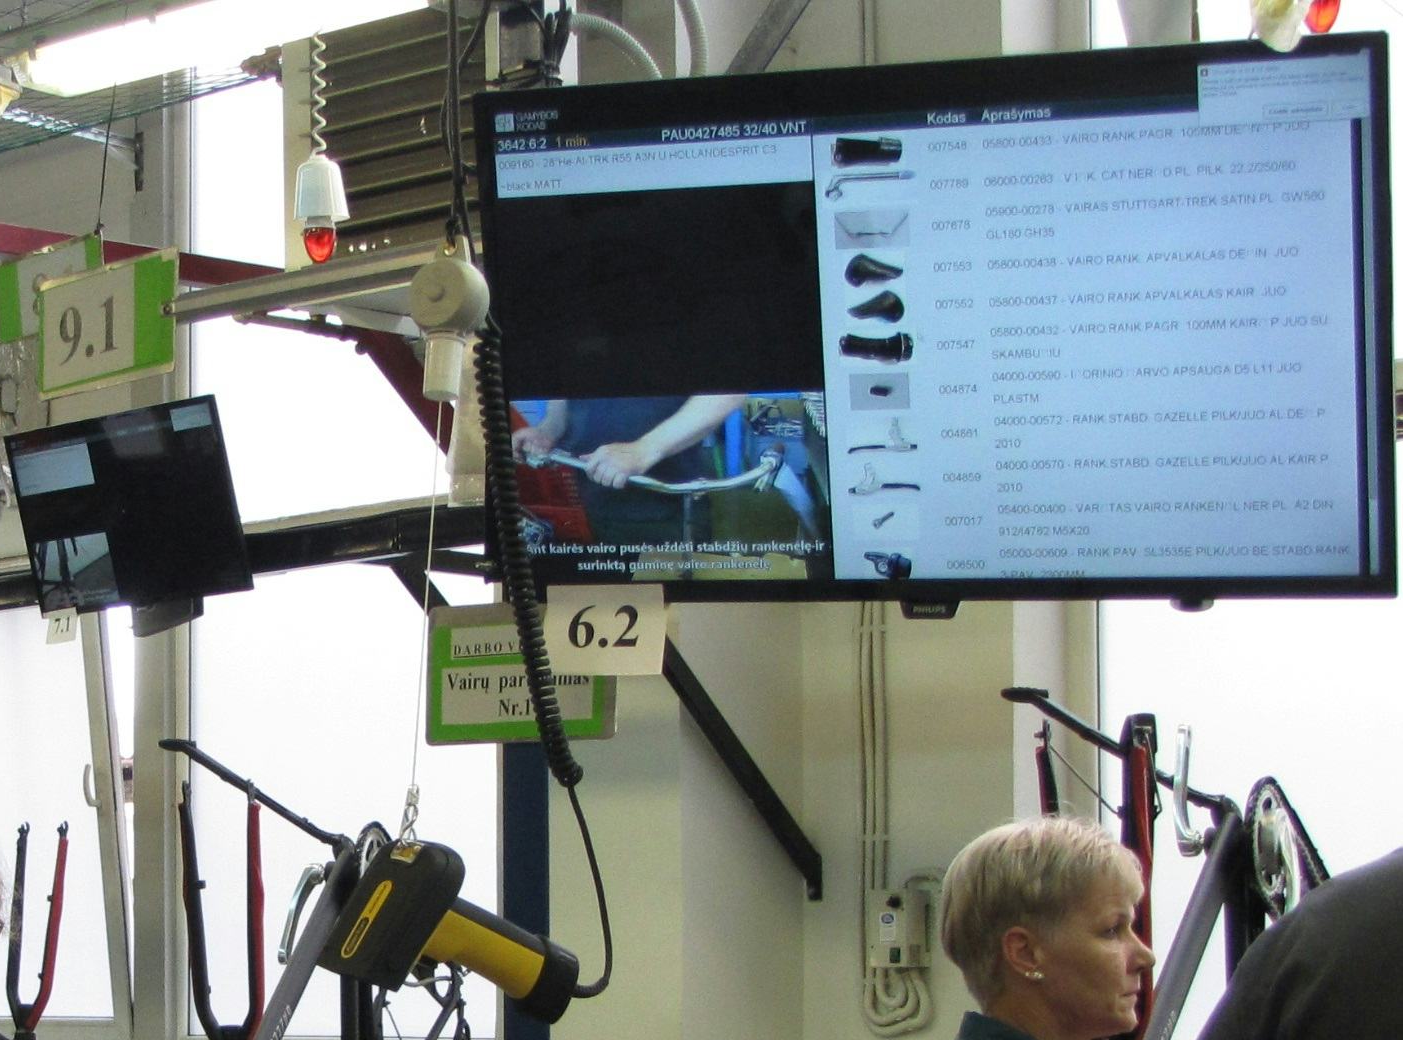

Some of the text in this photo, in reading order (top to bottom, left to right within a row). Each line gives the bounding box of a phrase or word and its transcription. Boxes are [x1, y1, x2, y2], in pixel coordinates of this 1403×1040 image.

[927, 112, 967, 124] Kodas
[981, 108, 1052, 124] Aprašymas
[661, 121, 807, 142] PAU0427485 32/40 VNT
[1066, 255, 1102, 267] VAIRO
[1067, 293, 1104, 304] VAIRO
[59, 295, 119, 367] 9.1
[1068, 323, 1105, 334] VAIRO
[1153, 410, 1207, 422] GAZELLE
[994, 438, 1021, 448] 2010
[1154, 456, 1209, 467] GAZELLE
[996, 482, 1022, 492] 2010
[943, 515, 983, 526] 007017
[550, 542, 583, 554] kairės
[587, 542, 617, 554] vairo
[620, 542, 654, 556] pusės
[657, 540, 693, 553] uždėti
[577, 558, 625, 573] surinktą
[912, 605, 946, 614] PHILIPS
[54, 616, 70, 633] 7.1
[567, 604, 639, 648] 6.2
[453, 642, 503, 656] DARBO
[446, 673, 490, 693] Vairų
